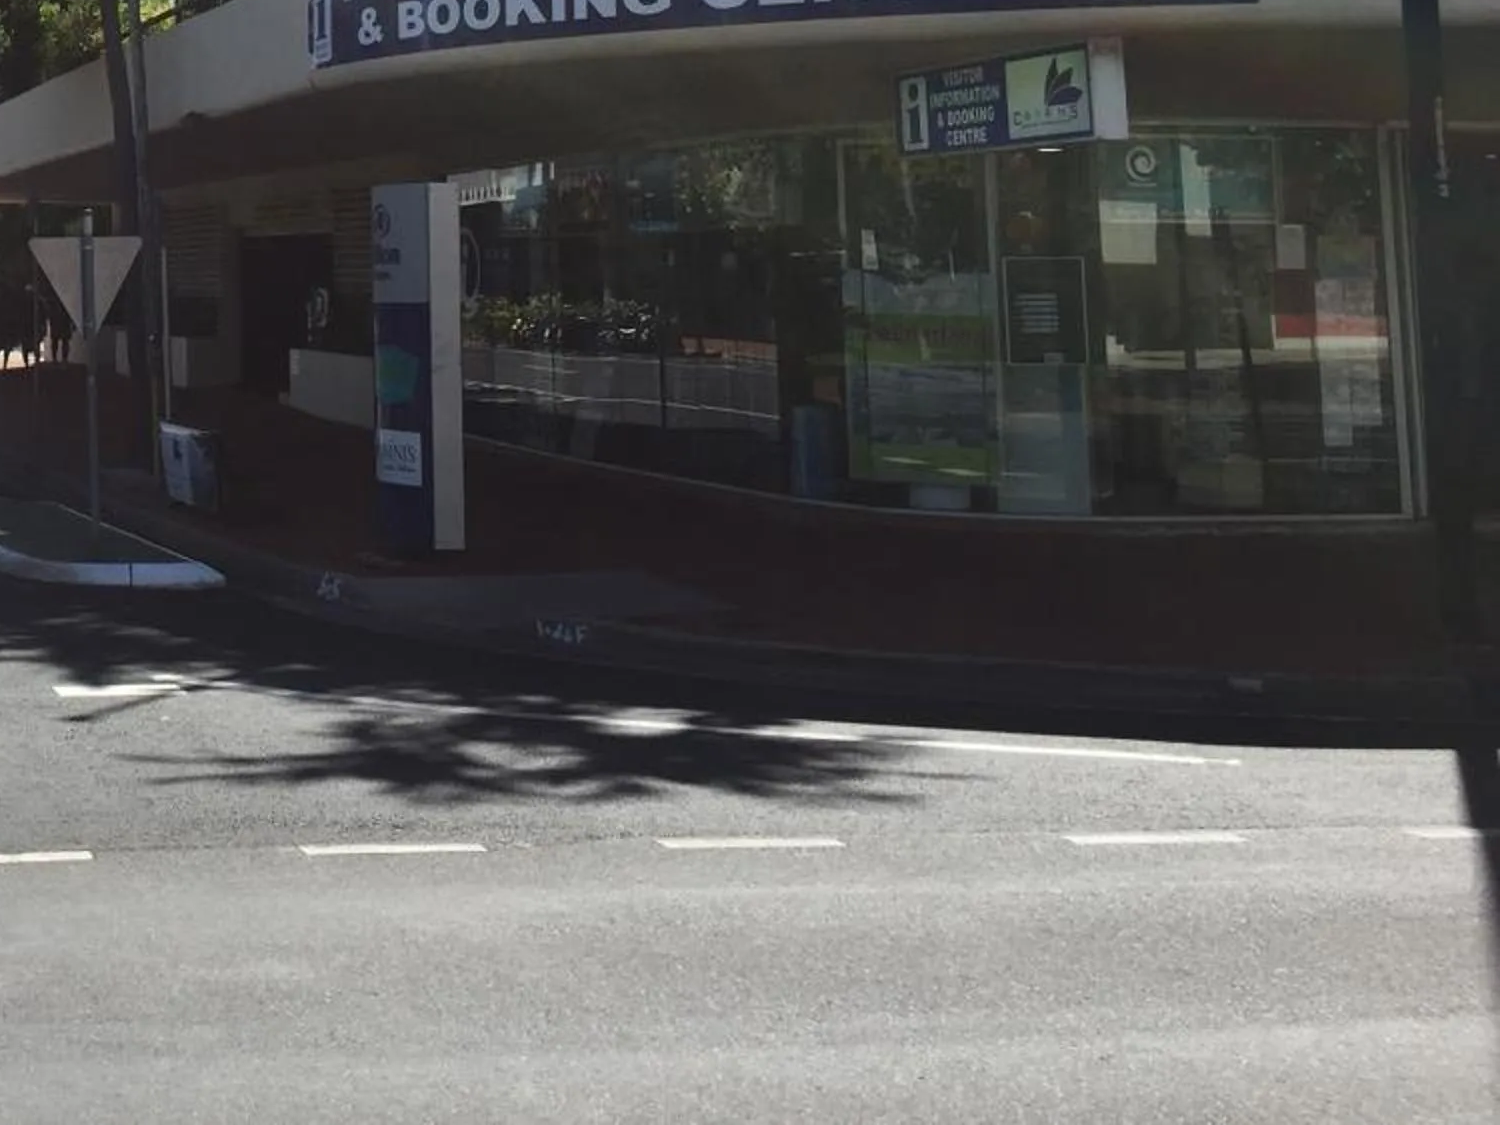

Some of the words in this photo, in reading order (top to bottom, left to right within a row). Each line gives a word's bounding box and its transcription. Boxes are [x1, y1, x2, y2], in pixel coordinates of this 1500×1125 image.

[357, 6, 384, 46] &
[929, 84, 1000, 109] INFORMATION
[946, 105, 995, 127] BOOKING
[946, 127, 989, 147] CENTRE
